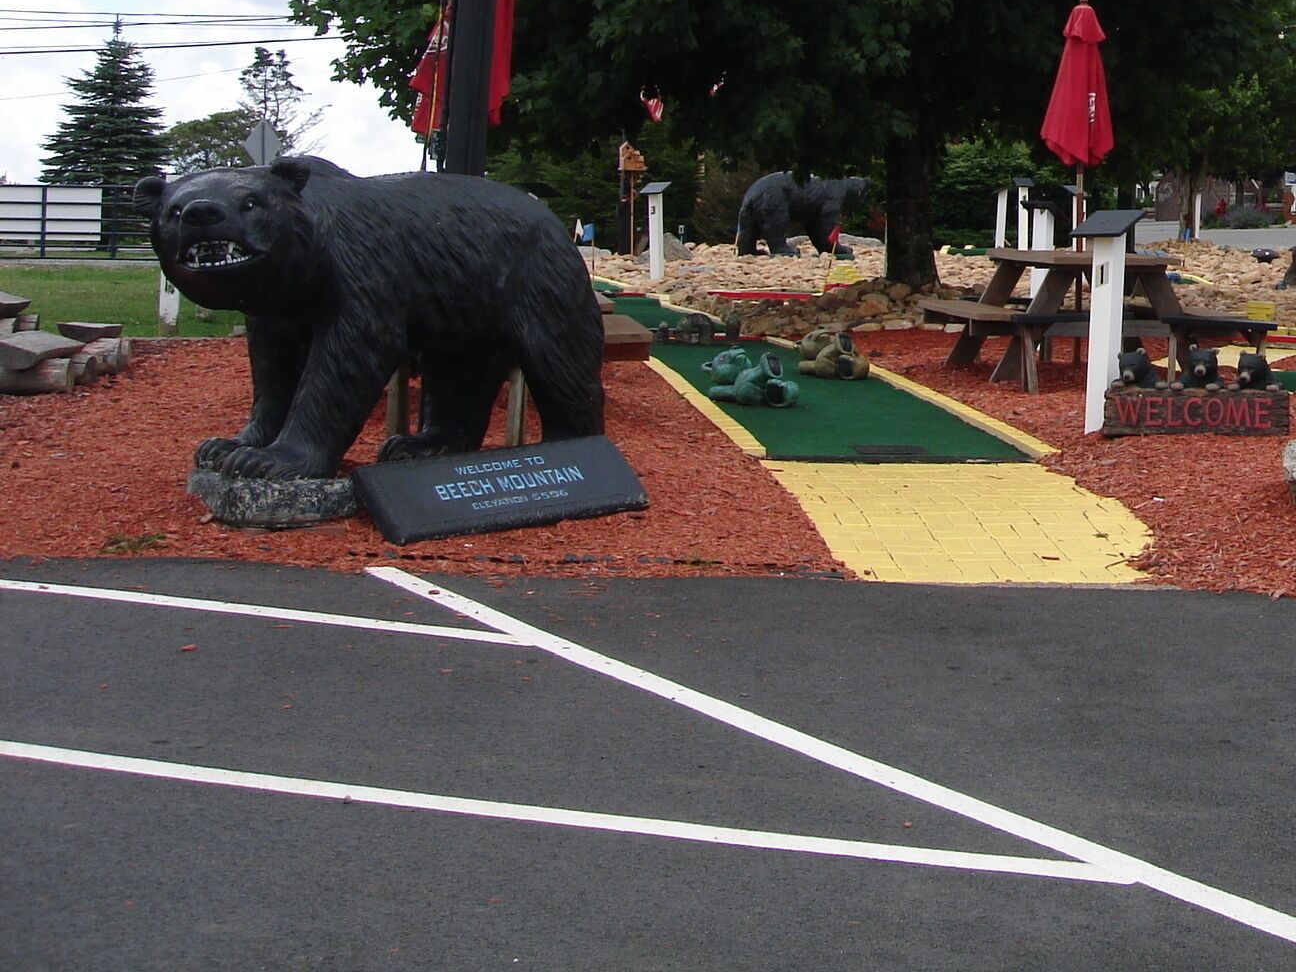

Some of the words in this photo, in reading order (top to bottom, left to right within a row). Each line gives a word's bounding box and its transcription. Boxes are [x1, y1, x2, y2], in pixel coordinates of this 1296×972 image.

[1114, 395, 1274, 429] WELCOME
[455, 459, 523, 476] WELCOME
[524, 456, 545, 467] TO
[434, 478, 496, 501] BEECH
[495, 466, 584, 492] MOUNTAIN
[471, 496, 529, 511] ELEVATION
